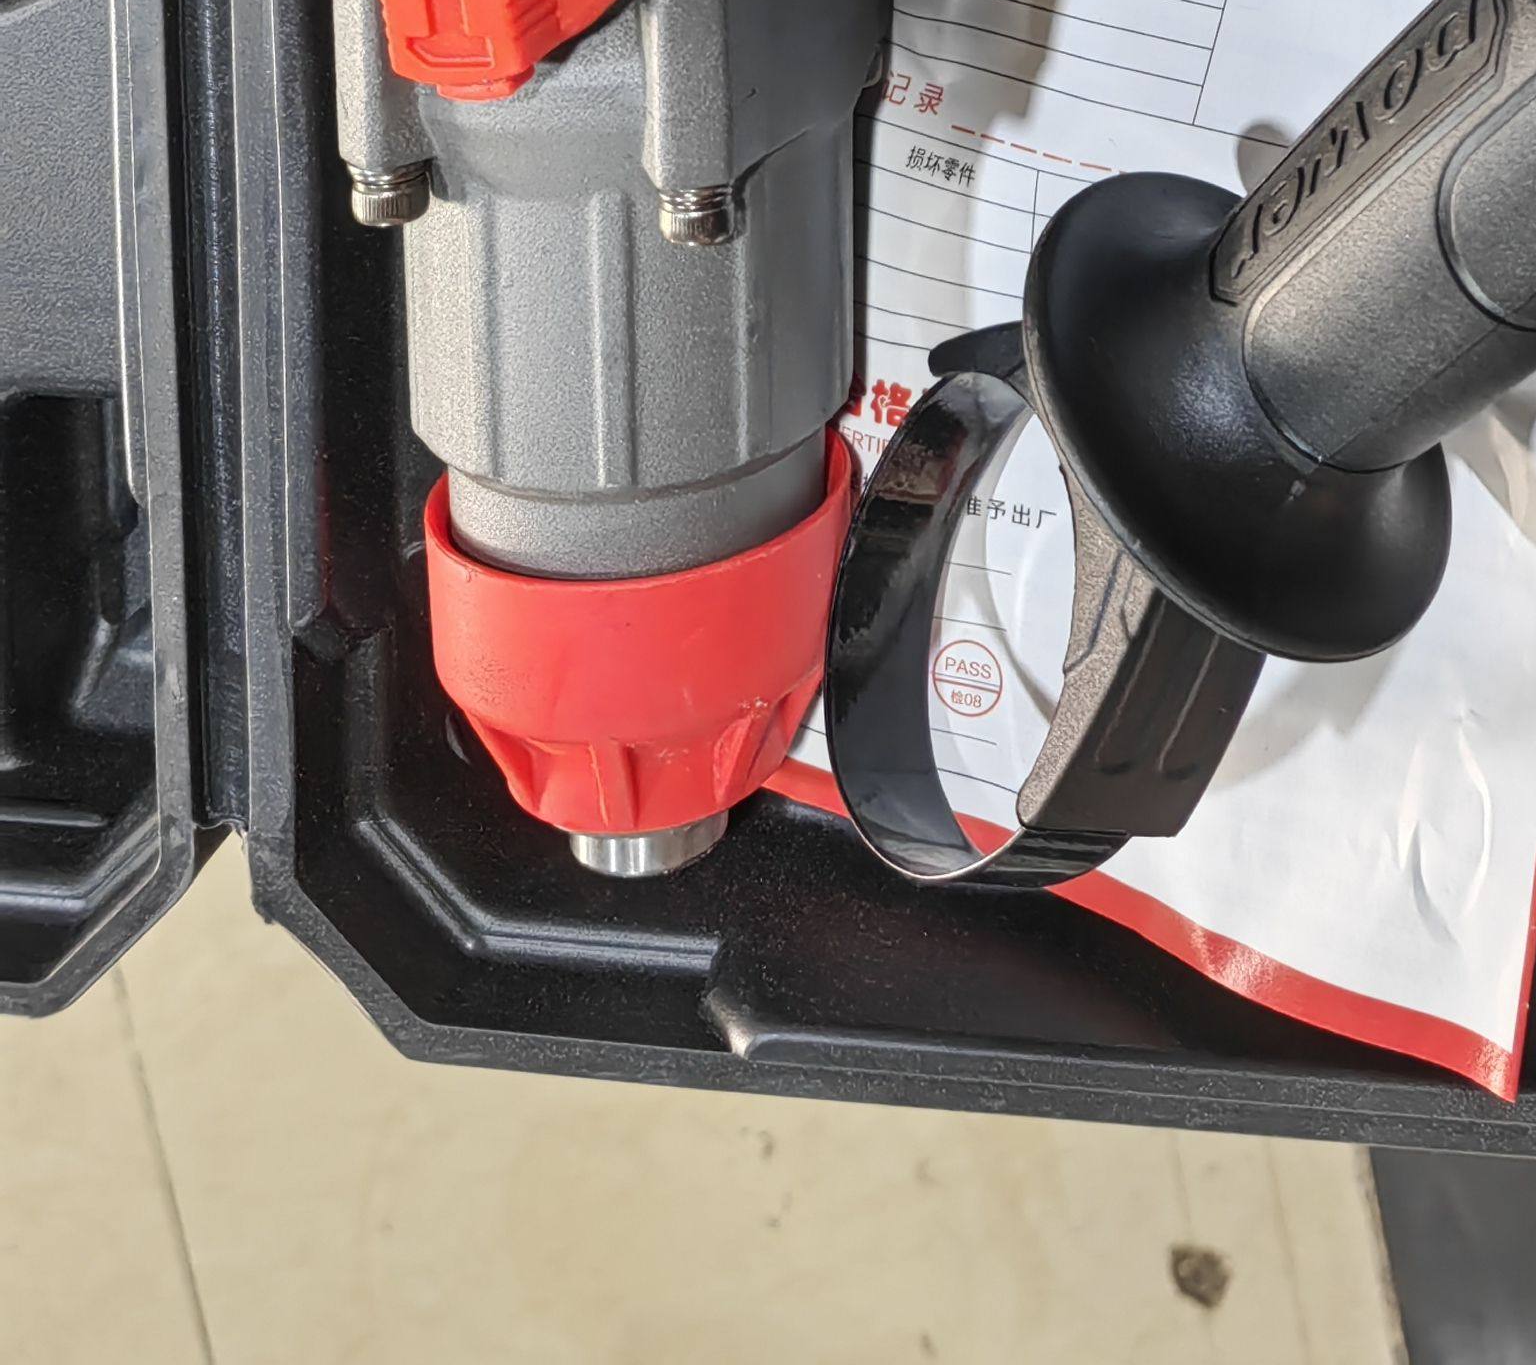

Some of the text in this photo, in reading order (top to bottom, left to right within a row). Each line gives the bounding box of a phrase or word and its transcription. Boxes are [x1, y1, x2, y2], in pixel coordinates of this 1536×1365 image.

[906, 146, 976, 188] 损坏零件
[945, 657, 992, 679] PASS
